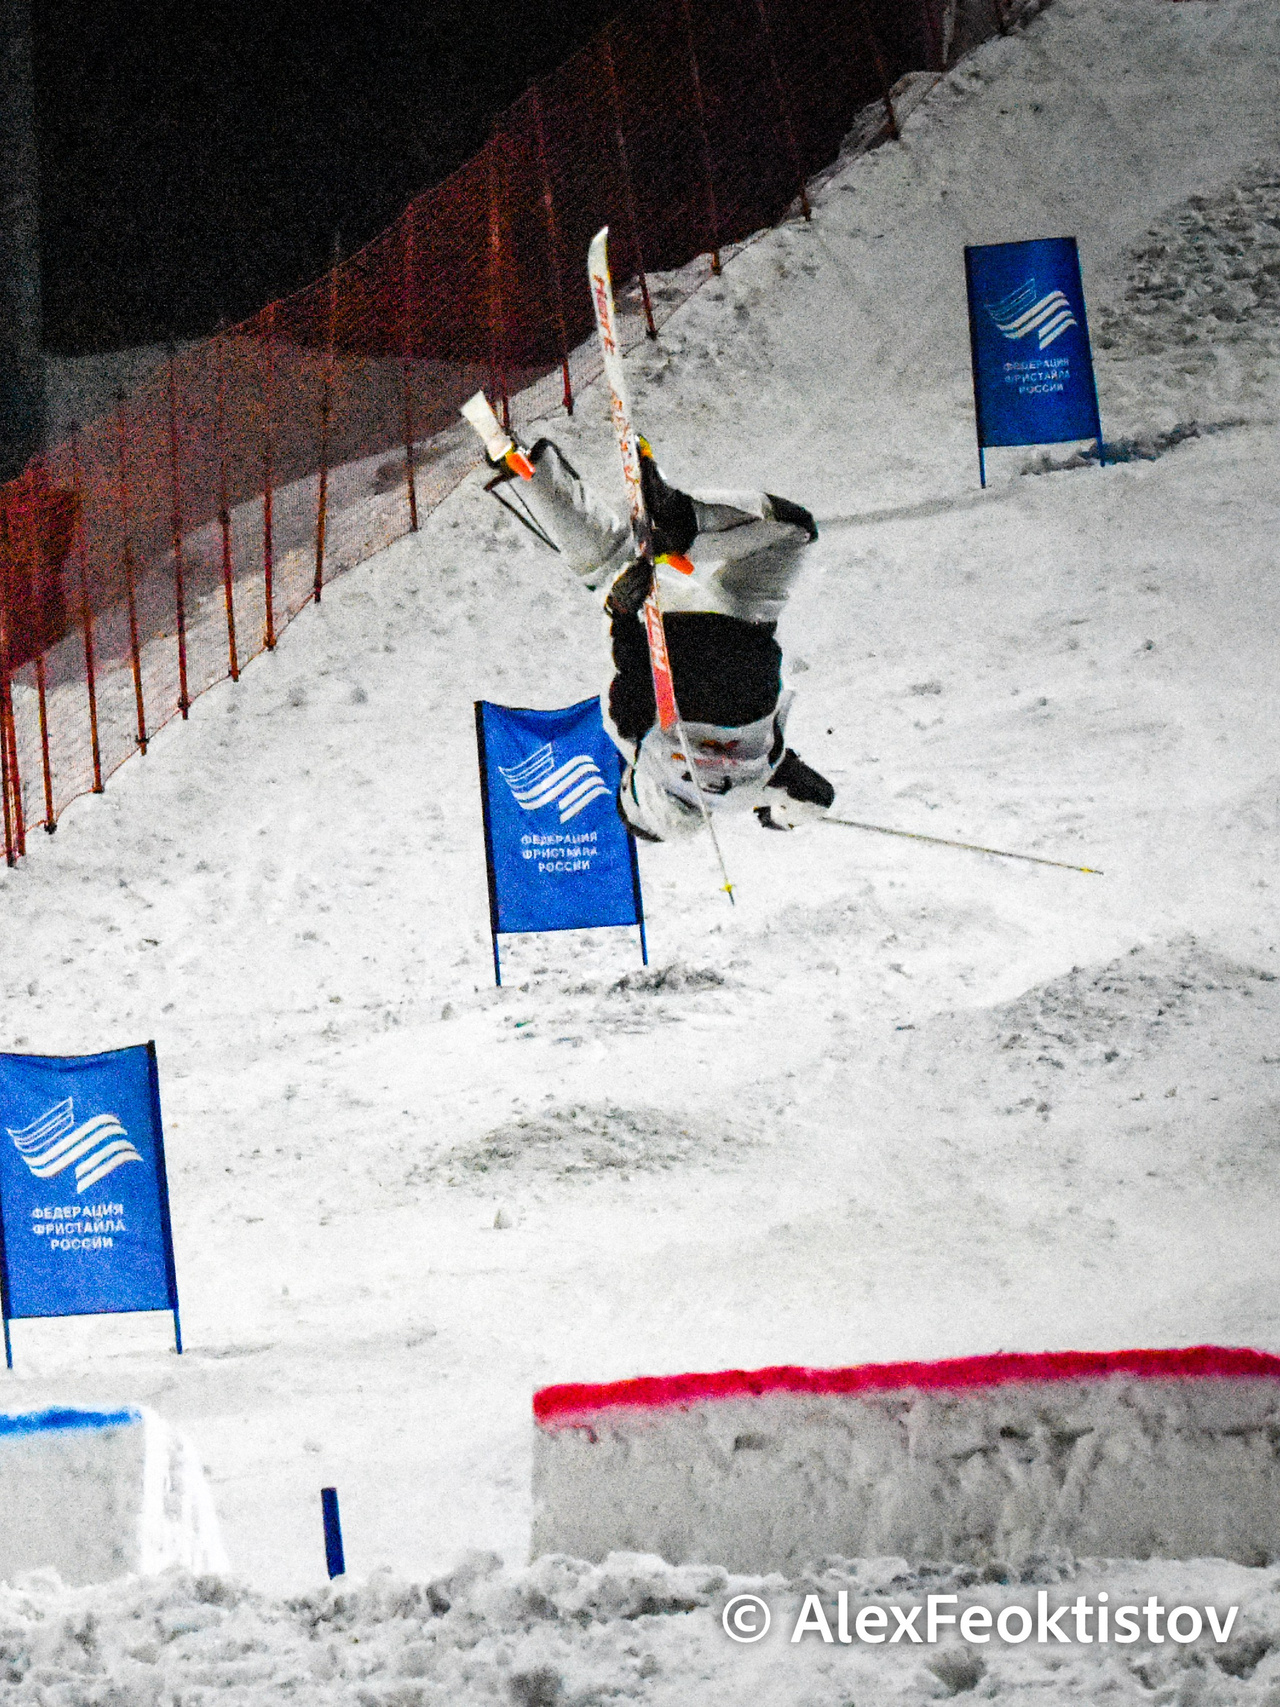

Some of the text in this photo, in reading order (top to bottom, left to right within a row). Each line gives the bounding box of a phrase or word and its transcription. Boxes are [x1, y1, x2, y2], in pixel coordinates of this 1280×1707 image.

[1003, 358, 1069, 371] ФЕДЕРАЦИЯ
[1005, 369, 1071, 383] ФРИСТАЙЛА
[1019, 383, 1064, 394] РОССИИ
[521, 831, 598, 846] ФЕДЕРАЦИЯ
[522, 845, 598, 860] ФРИСТАЙЛА
[538, 859, 590, 873] РОССИИ
[32, 1202, 124, 1220] ФЕДЕРАЦИЯ
[32, 1220, 126, 1235] ФРИСТАЙЛА
[51, 1236, 113, 1250] РОССИИ
